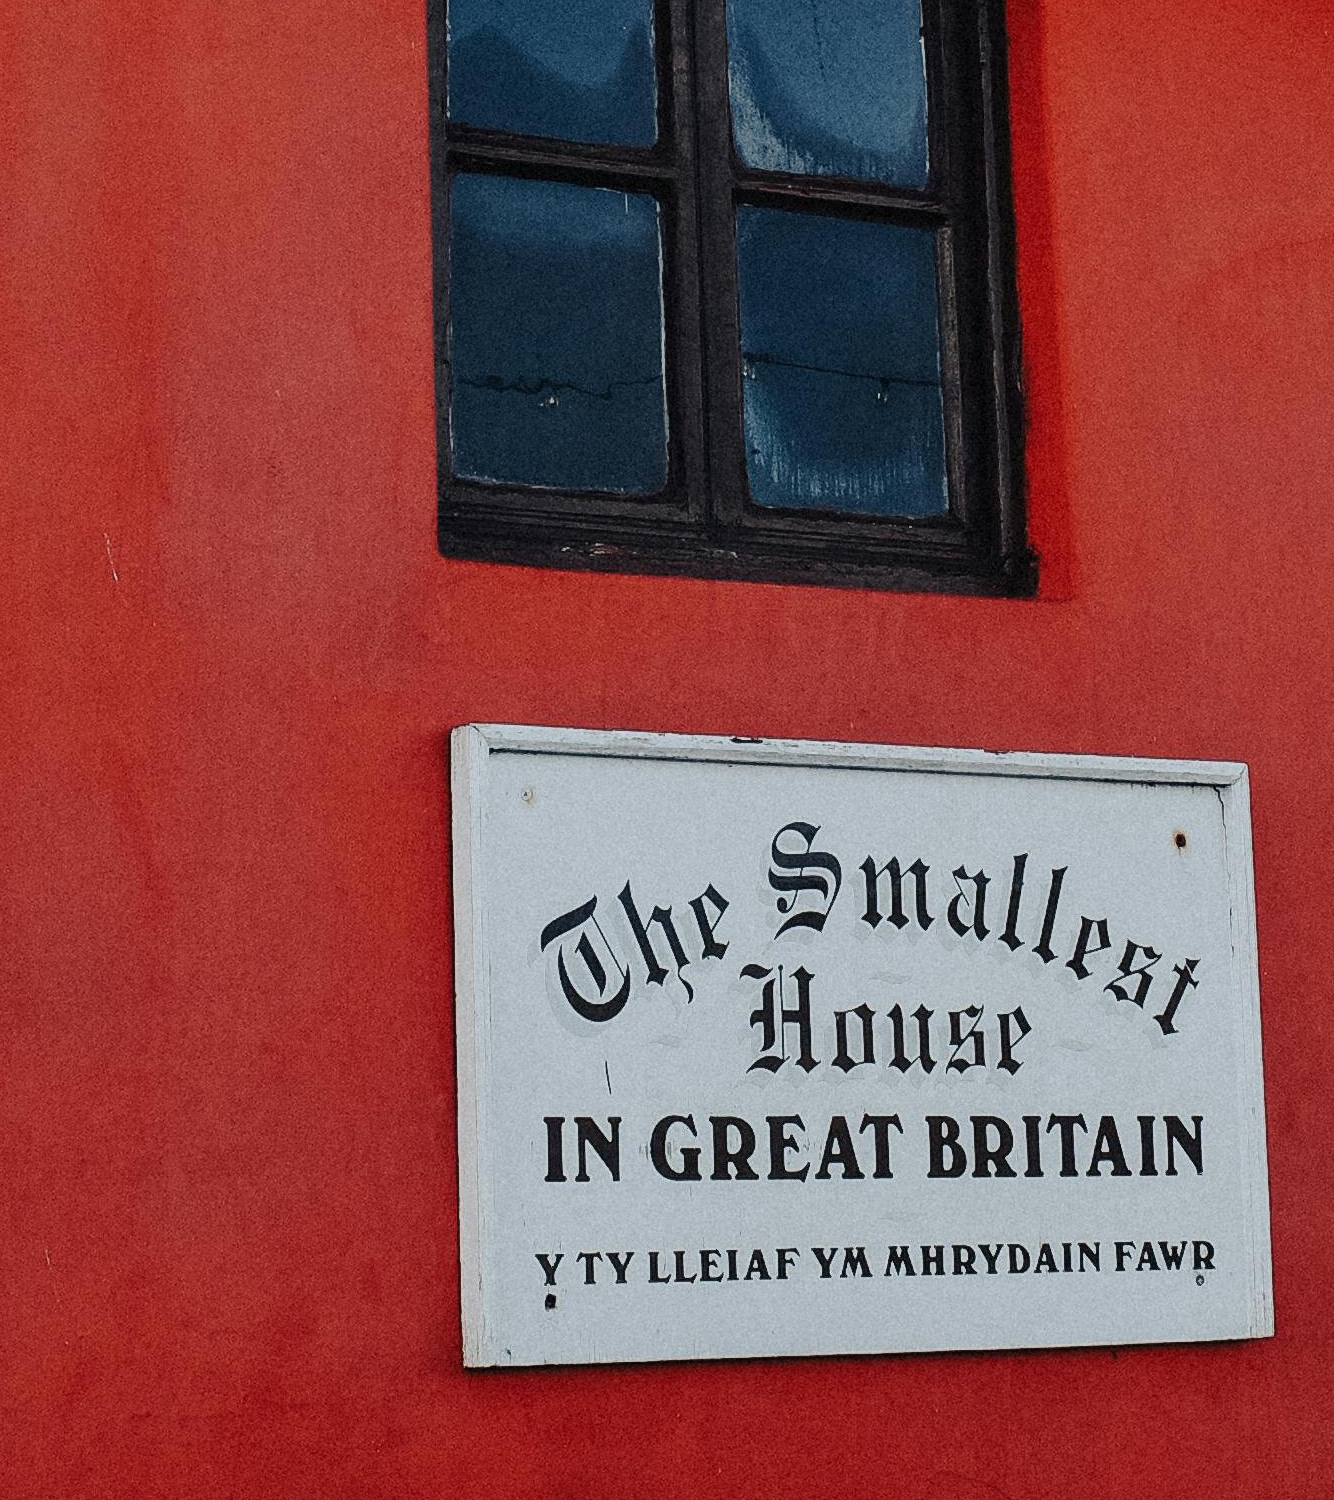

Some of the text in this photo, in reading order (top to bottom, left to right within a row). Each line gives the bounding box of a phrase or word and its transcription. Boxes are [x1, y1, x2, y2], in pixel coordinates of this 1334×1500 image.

[540, 821, 1202, 1036] The Smallest
[742, 964, 1033, 1077] House
[542, 1112, 1205, 1183] IN GREAT BRITAIN
[534, 1238, 1216, 1287] Y TY LLEIAF YM MHRYDAIN FAWR
